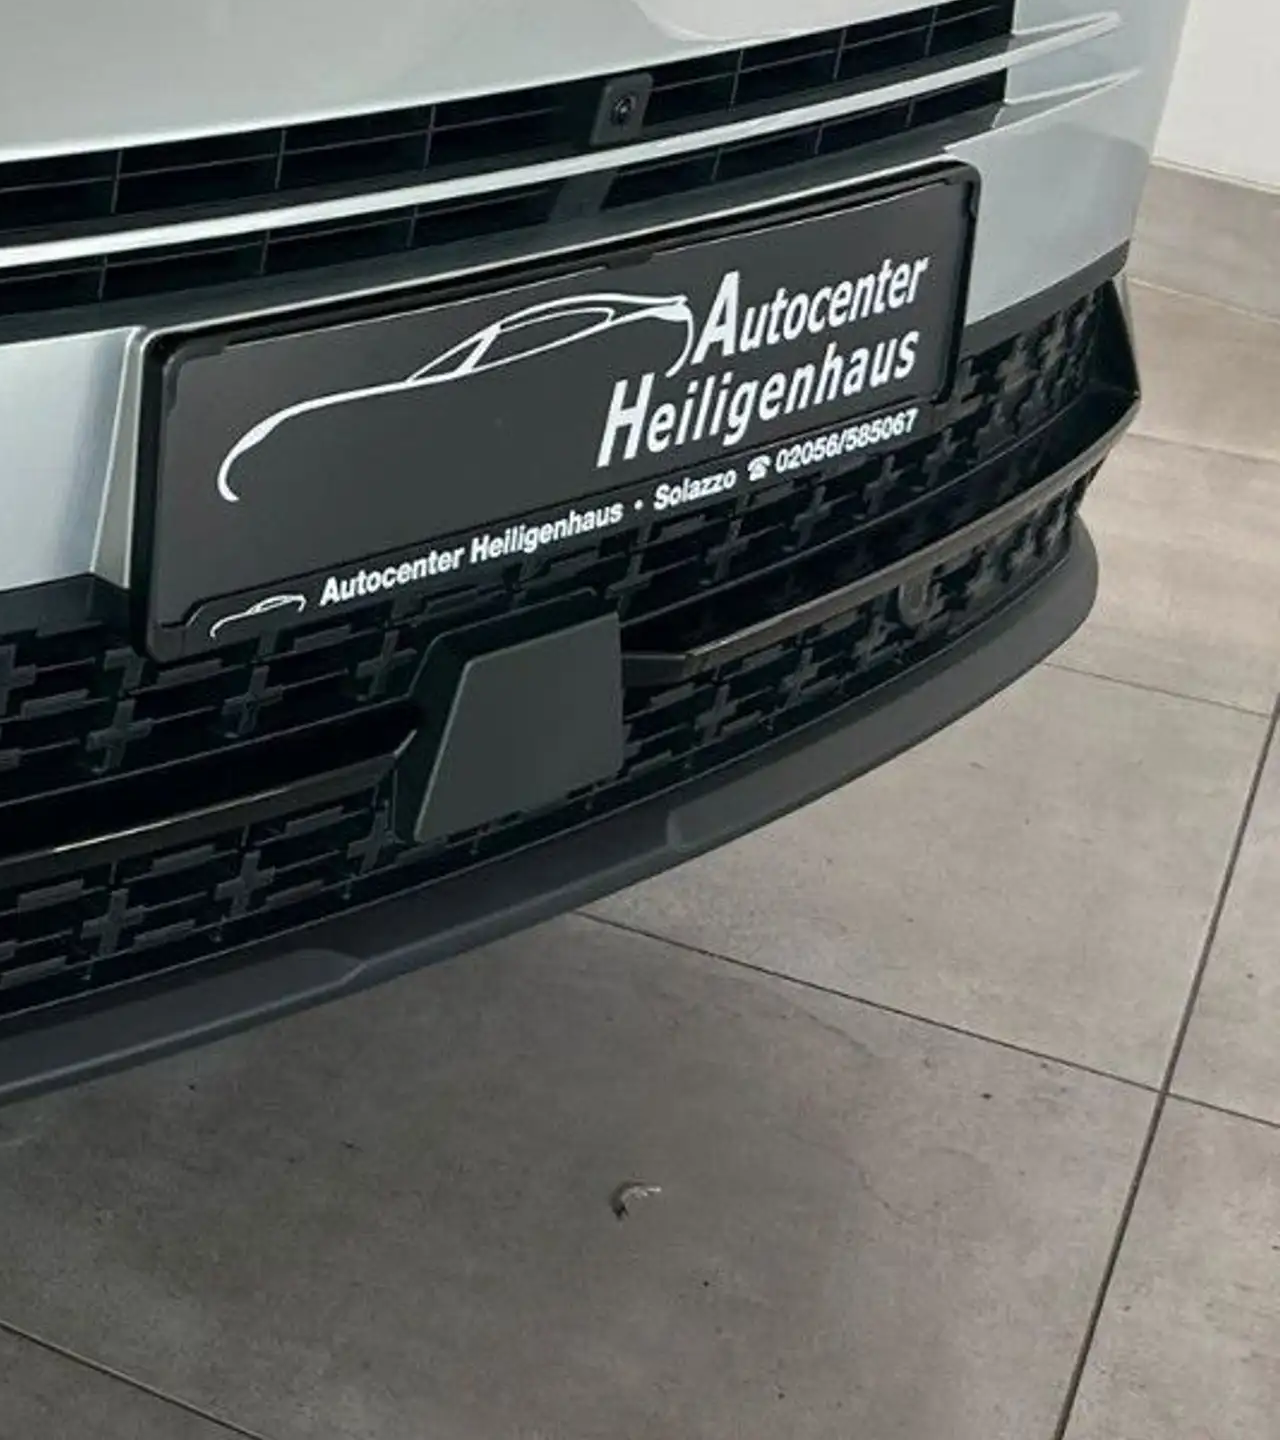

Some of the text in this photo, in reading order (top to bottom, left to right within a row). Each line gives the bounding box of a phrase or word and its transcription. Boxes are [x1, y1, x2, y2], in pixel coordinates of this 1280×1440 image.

[691, 257, 929, 365] Autocenter
[596, 330, 920, 468] Heiligenhaus
[319, 407, 920, 607] Autocenter Heiligenhaus Solazzo 02056/585067
